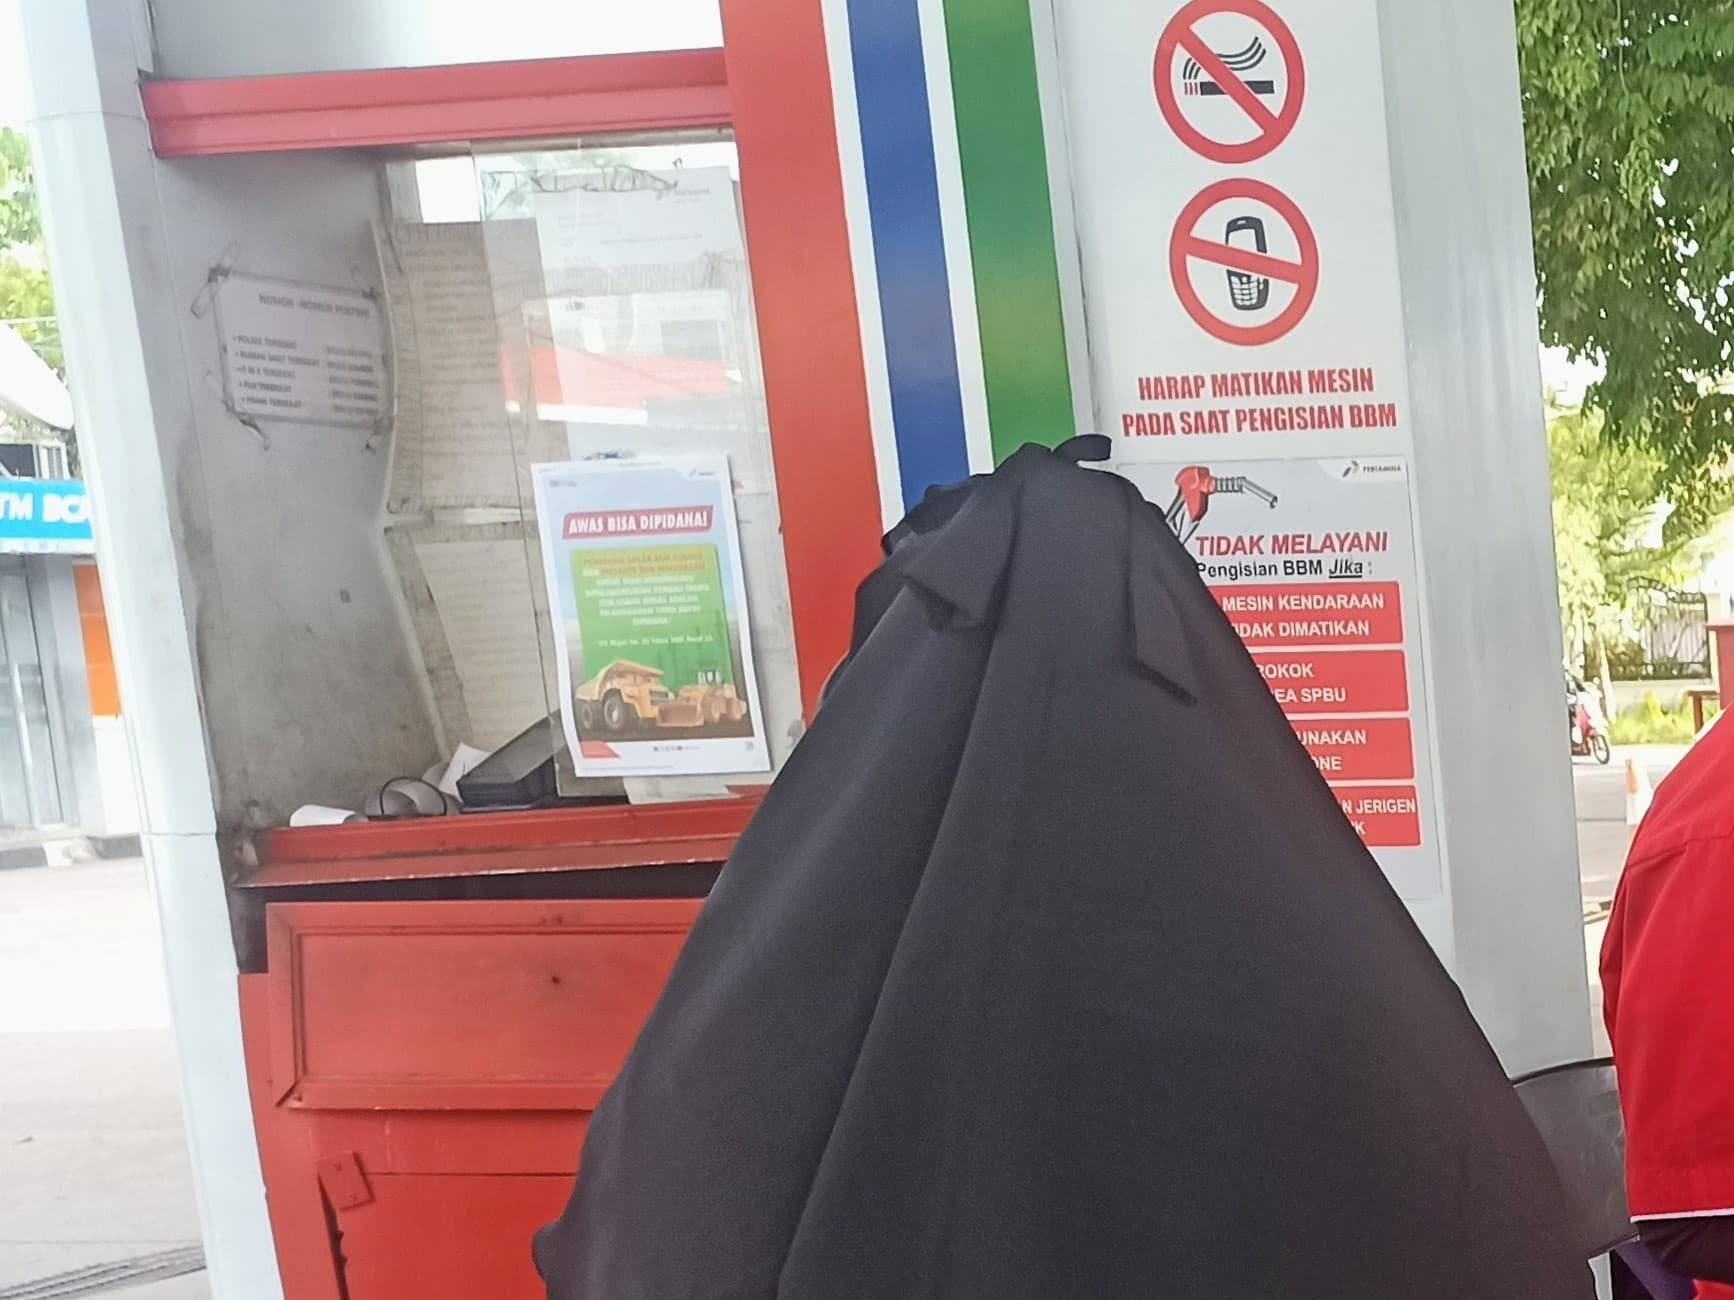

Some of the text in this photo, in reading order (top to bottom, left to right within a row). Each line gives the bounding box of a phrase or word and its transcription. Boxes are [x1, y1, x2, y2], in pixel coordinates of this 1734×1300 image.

[1138, 367, 1374, 400] HARAP MATIKAN MESIN
[1122, 403, 1397, 437] PADA SAAT PENGISIAN BBM
[569, 512, 708, 534] AWAS BISA DIPIDANA!
[1195, 532, 1388, 556] TIDAK MELAYANI
[1196, 561, 1278, 581] Pengisian
[1284, 560, 1323, 576] BBM
[1329, 559, 1363, 576] Jika
[1222, 593, 1384, 612] MESIN KENDARAAN
[1231, 620, 1369, 638] IDAK DIMATIKAN
[1272, 687, 1346, 703] EA SPBU
[1355, 799, 1415, 814] JERIGEN
